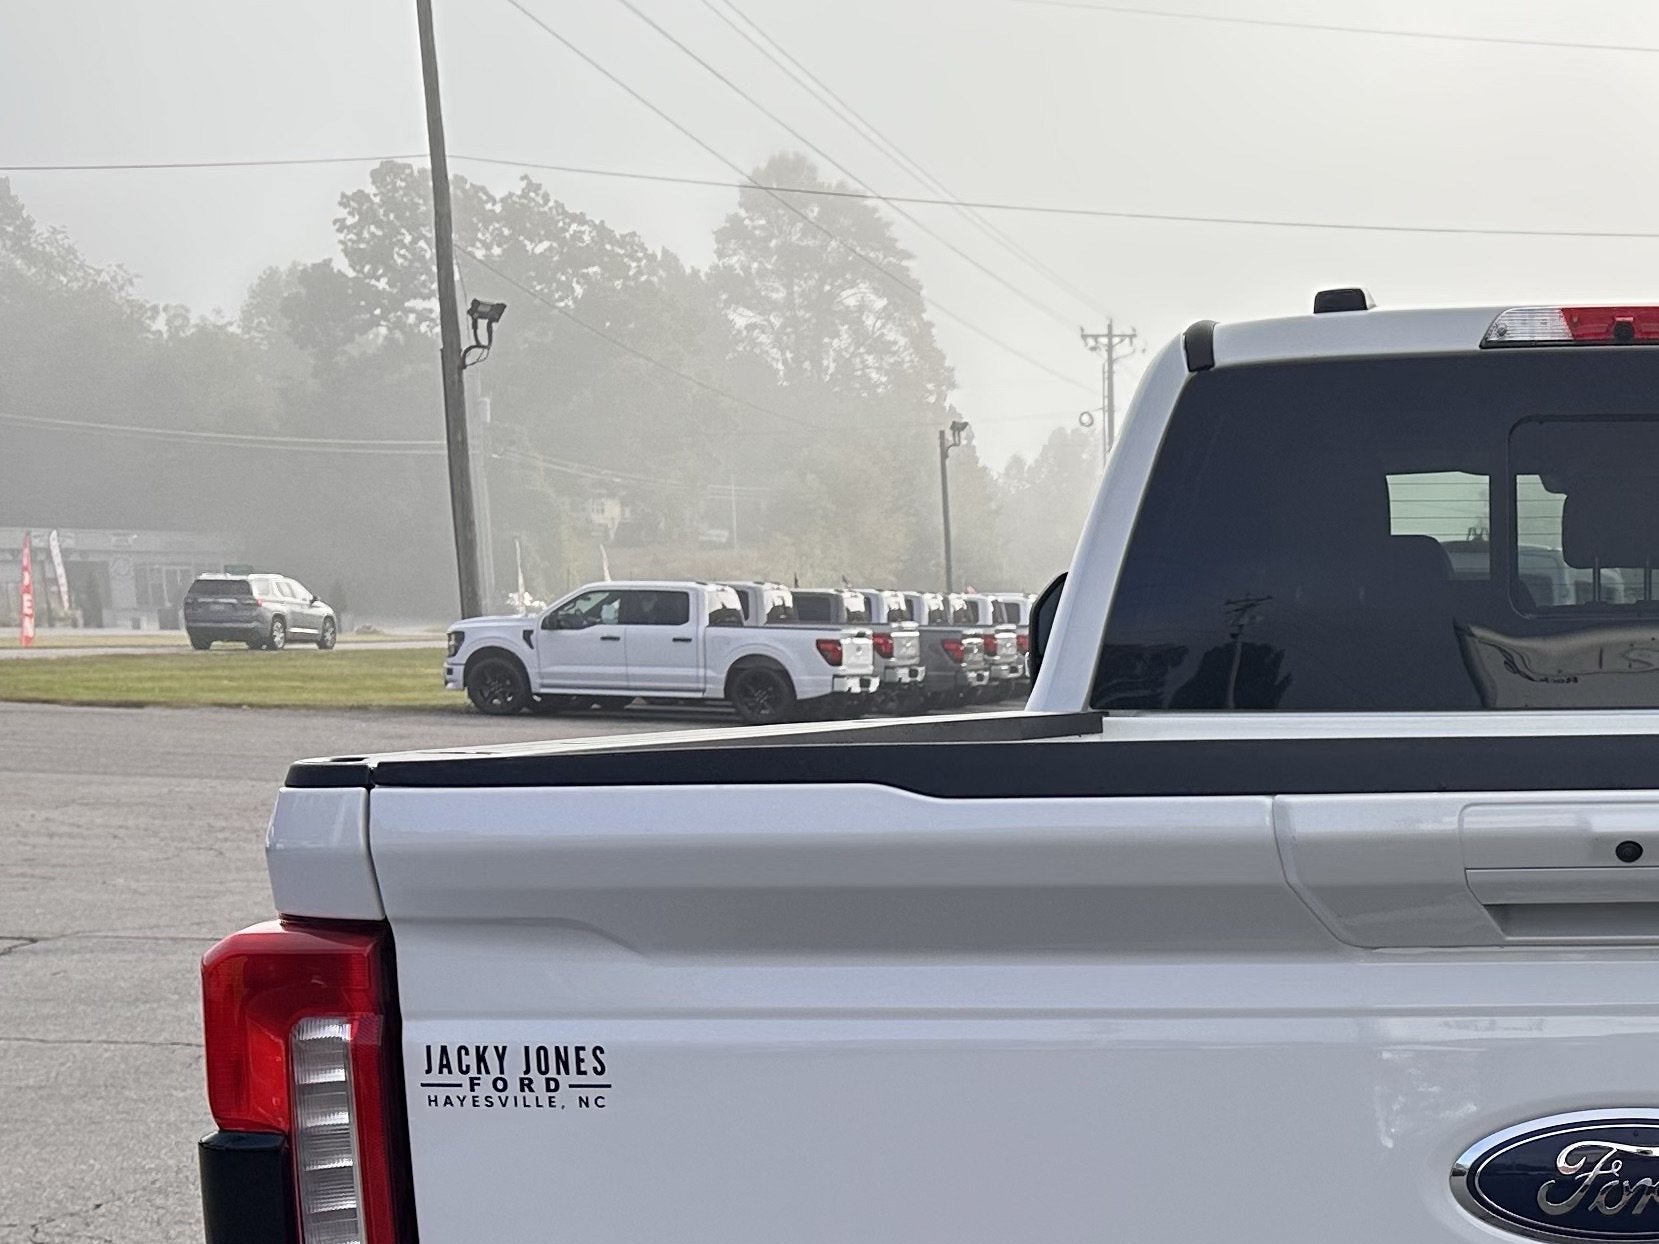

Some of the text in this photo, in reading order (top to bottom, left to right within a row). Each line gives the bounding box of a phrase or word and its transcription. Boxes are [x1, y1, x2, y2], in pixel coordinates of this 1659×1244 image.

[424, 1045, 607, 1076] JACKY JONES
[468, 1076, 561, 1093] FORD
[427, 1095, 607, 1110] HAYESVILLE, NC
